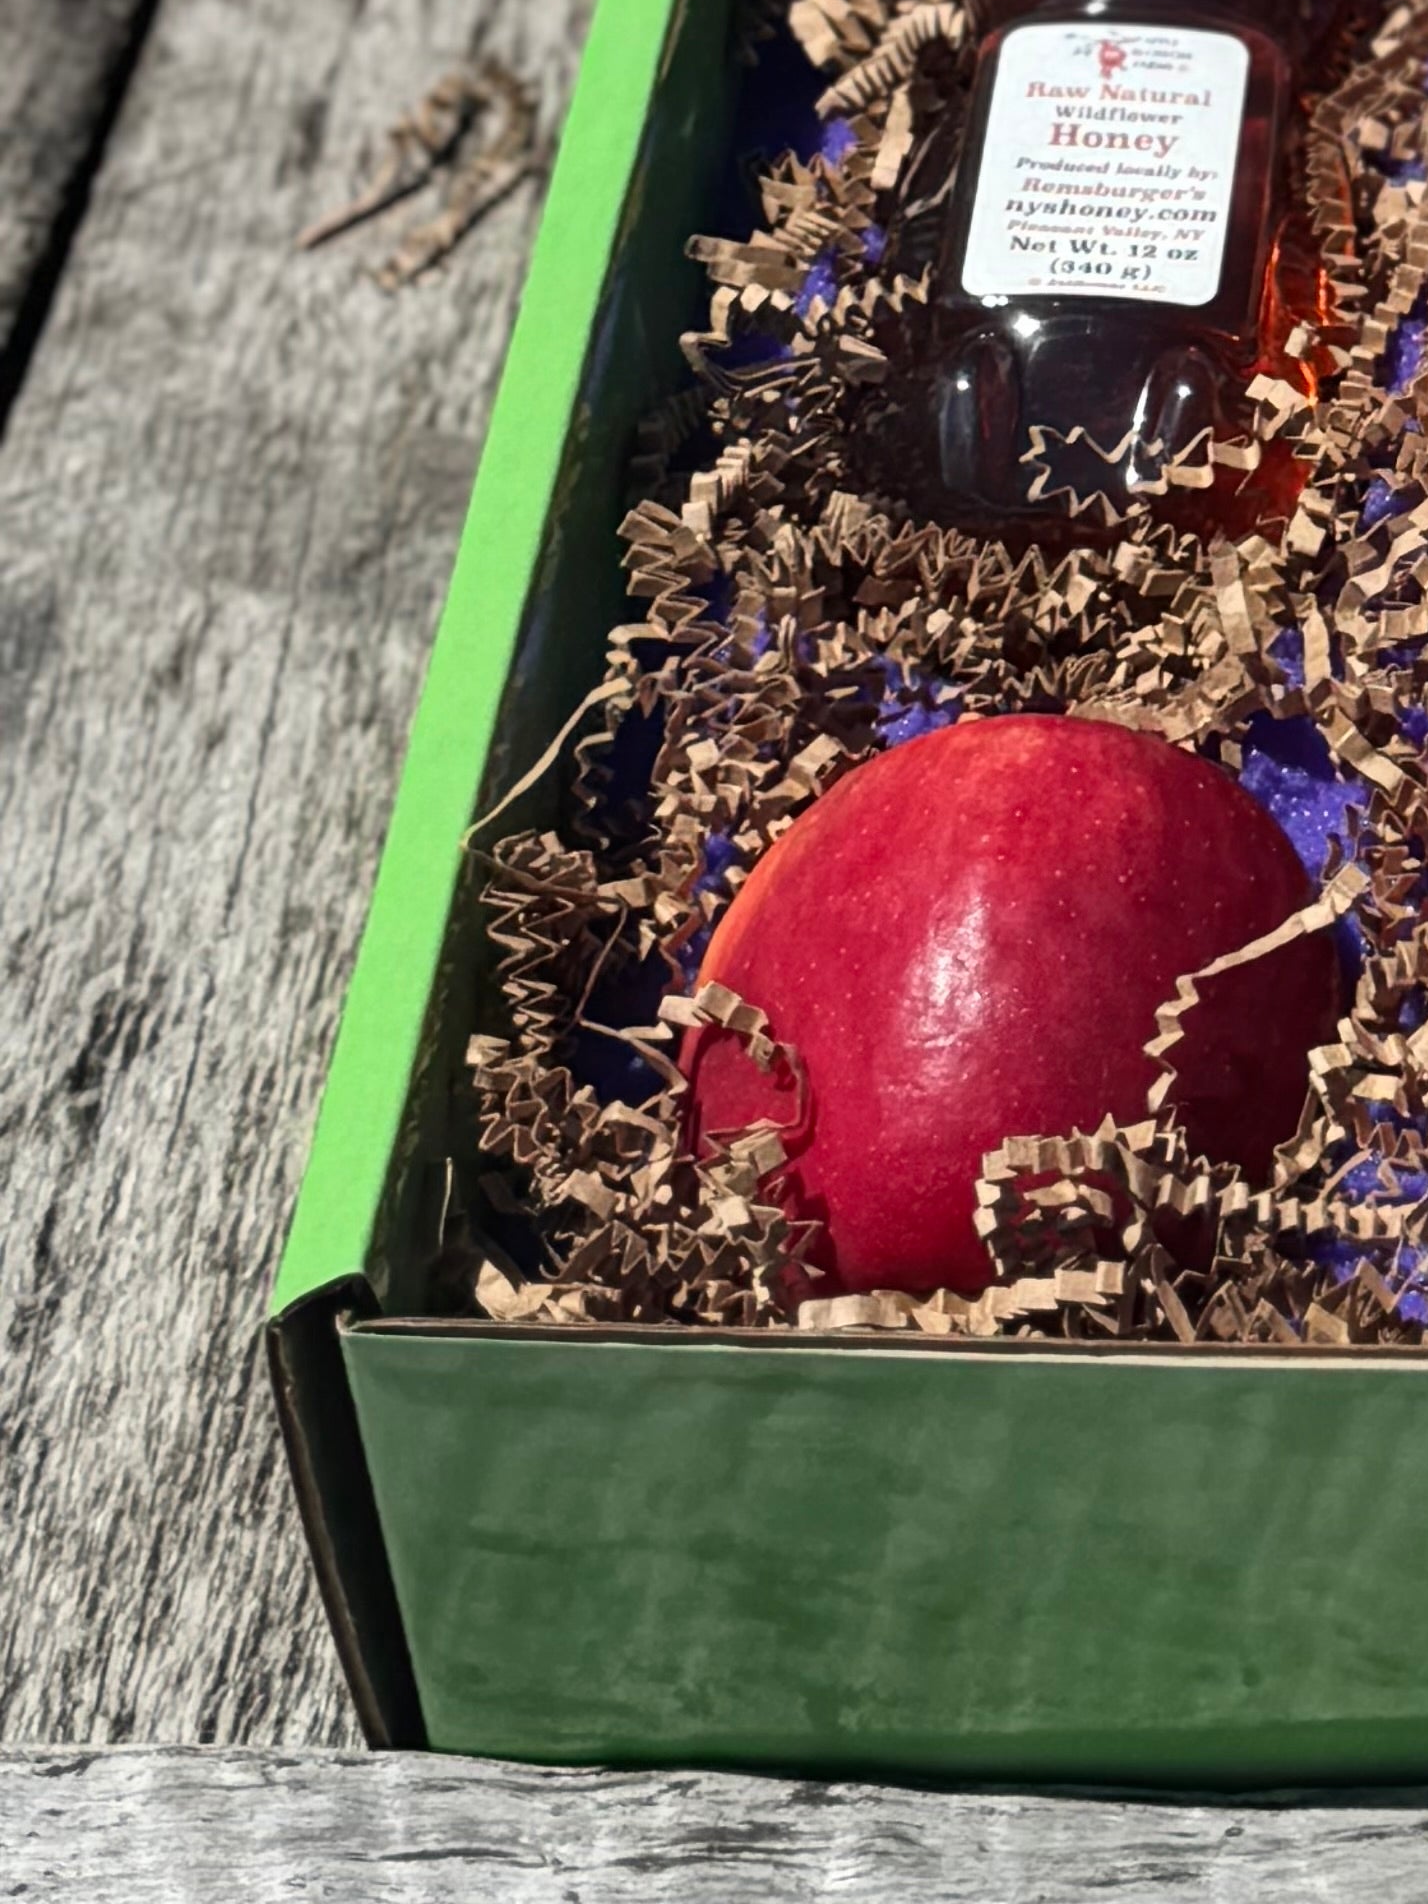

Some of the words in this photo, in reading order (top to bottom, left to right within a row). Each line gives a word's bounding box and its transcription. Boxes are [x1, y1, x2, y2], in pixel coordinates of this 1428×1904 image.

[1025, 81, 1091, 98] Raw
[1100, 83, 1212, 107] Natural
[1055, 104, 1183, 125] Wildflower
[1049, 122, 1180, 158] Honey
[1015, 156, 1110, 175] Produced
[1115, 161, 1182, 181] locally
[1004, 198, 1218, 224] nyshoney.com
[1006, 218, 1095, 236] Pleasant
[1172, 228, 1206, 242] NY
[1009, 235, 1057, 254] Net
[1069, 239, 1117, 256] Wt.
[1123, 244, 1158, 259] 12
[1166, 248, 1200, 261] oz
[1049, 257, 1113, 277] (340
[1120, 265, 1153, 281] g)
